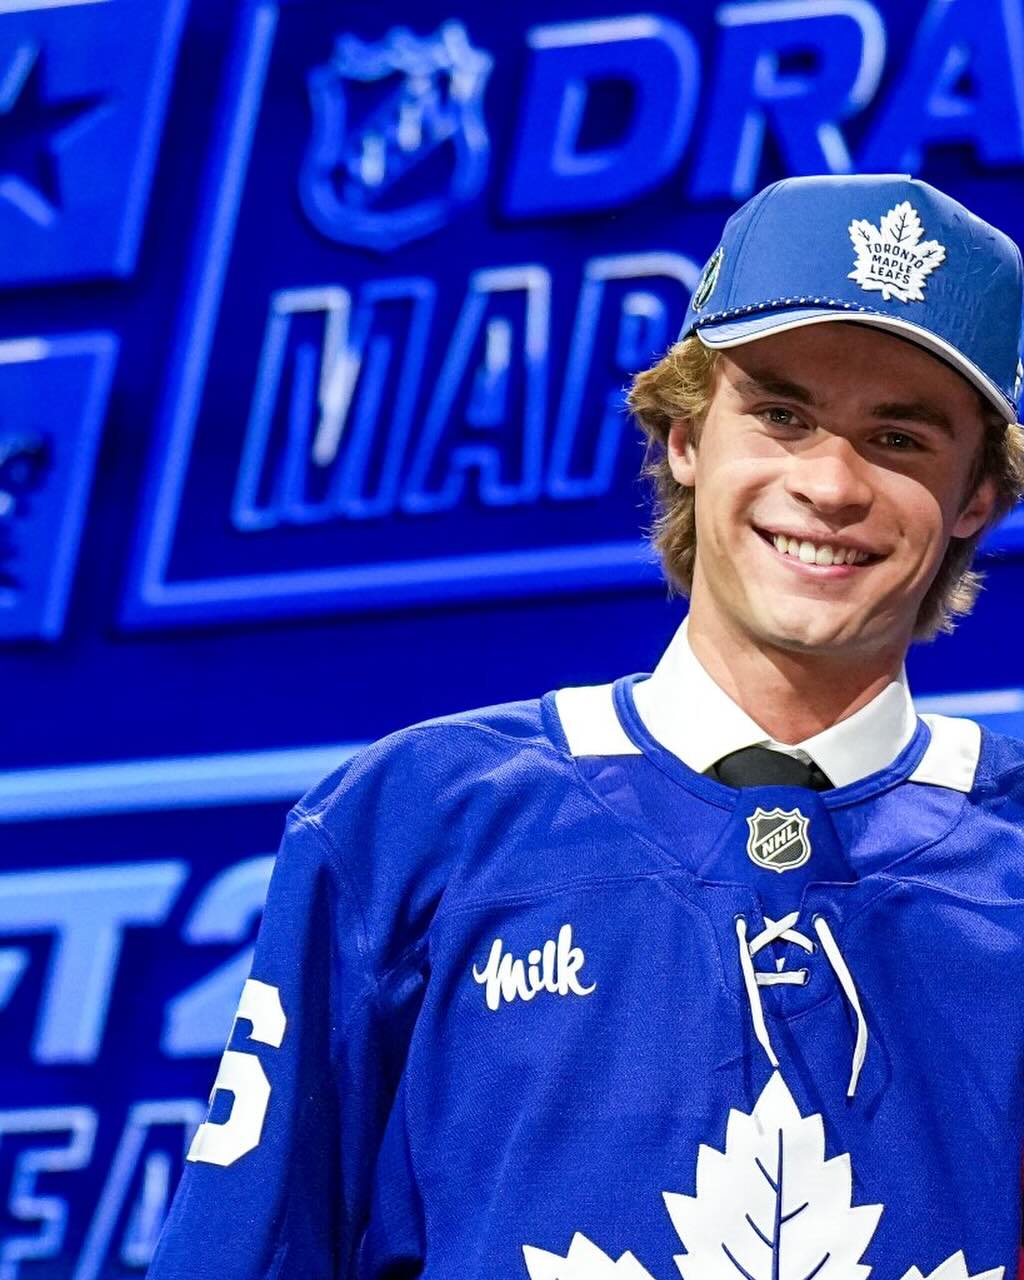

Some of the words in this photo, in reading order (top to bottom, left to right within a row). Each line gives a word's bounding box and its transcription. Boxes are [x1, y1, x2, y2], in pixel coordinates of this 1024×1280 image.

[865, 243, 924, 269] TORONTO
[871, 254, 912, 274] MAPLE
[870, 264, 911, 285] LEAFS
[761, 824, 799, 858] NHL
